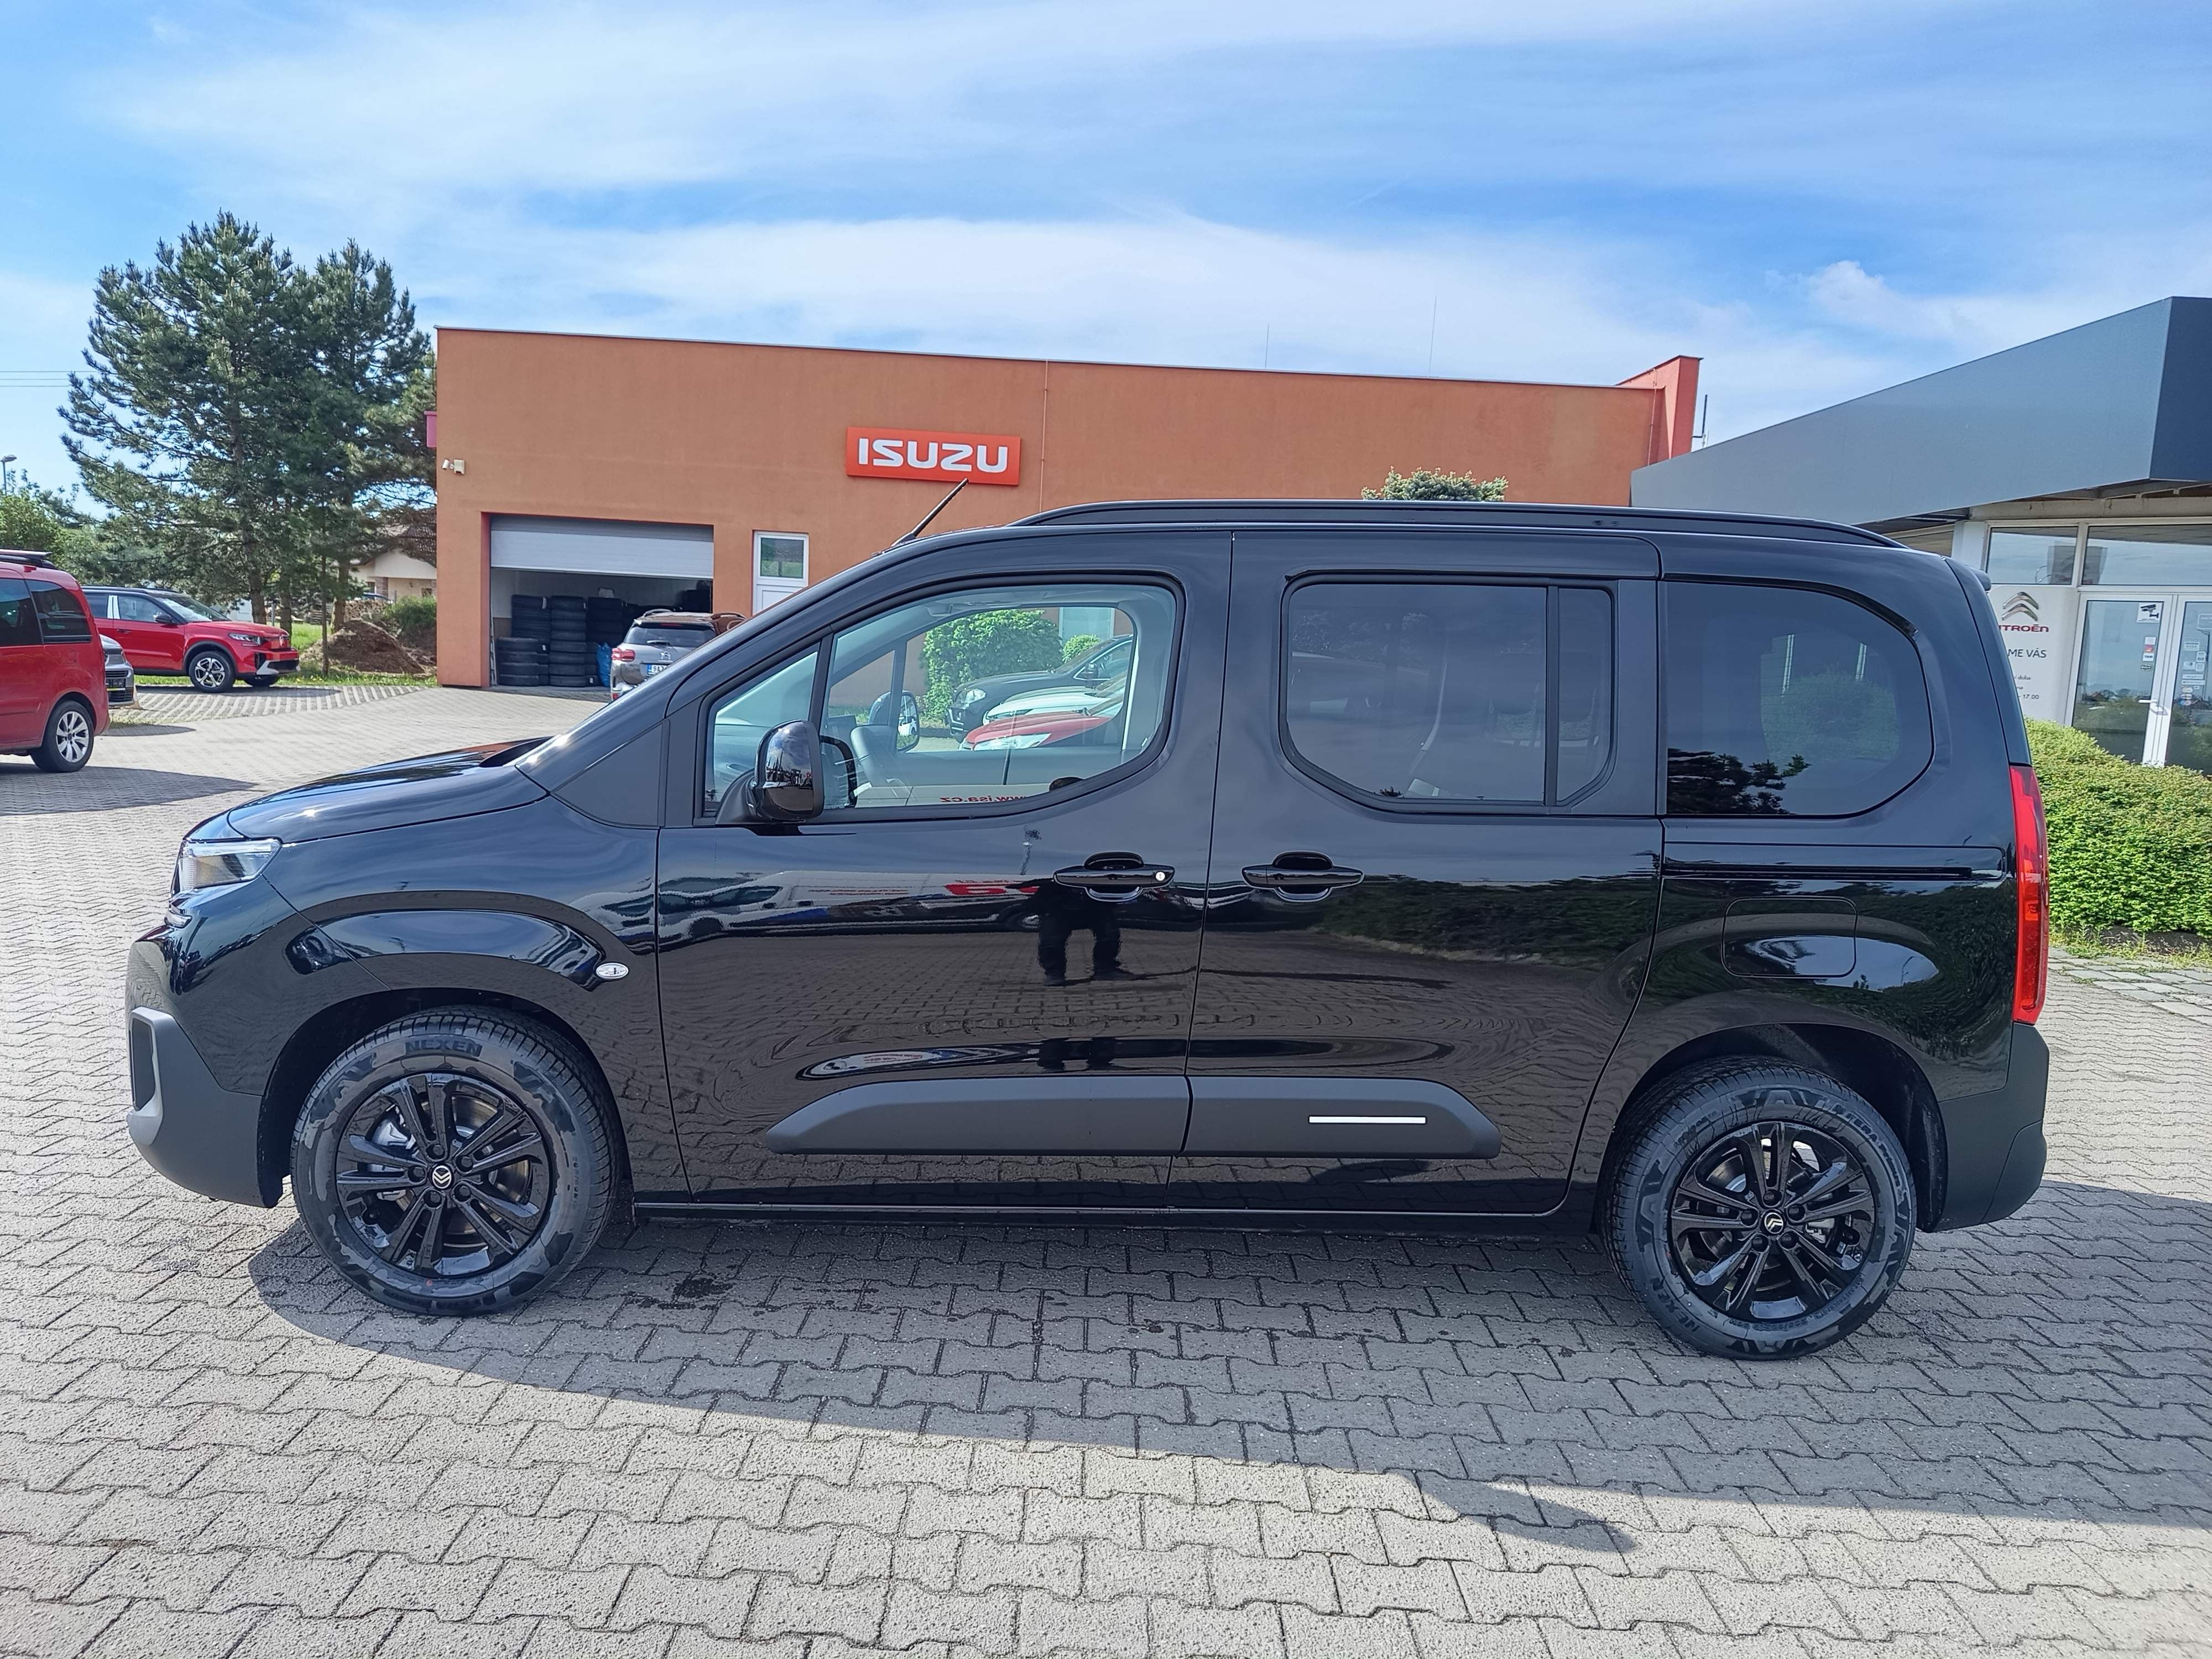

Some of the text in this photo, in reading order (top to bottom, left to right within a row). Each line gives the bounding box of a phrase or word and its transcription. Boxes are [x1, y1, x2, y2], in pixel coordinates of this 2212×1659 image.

[858, 437, 1008, 473] ISUZU
[1998, 624, 2049, 632] ITROËN
[2026, 648, 2047, 658] VÁS
[405, 1039, 483, 1057] NEXEN
